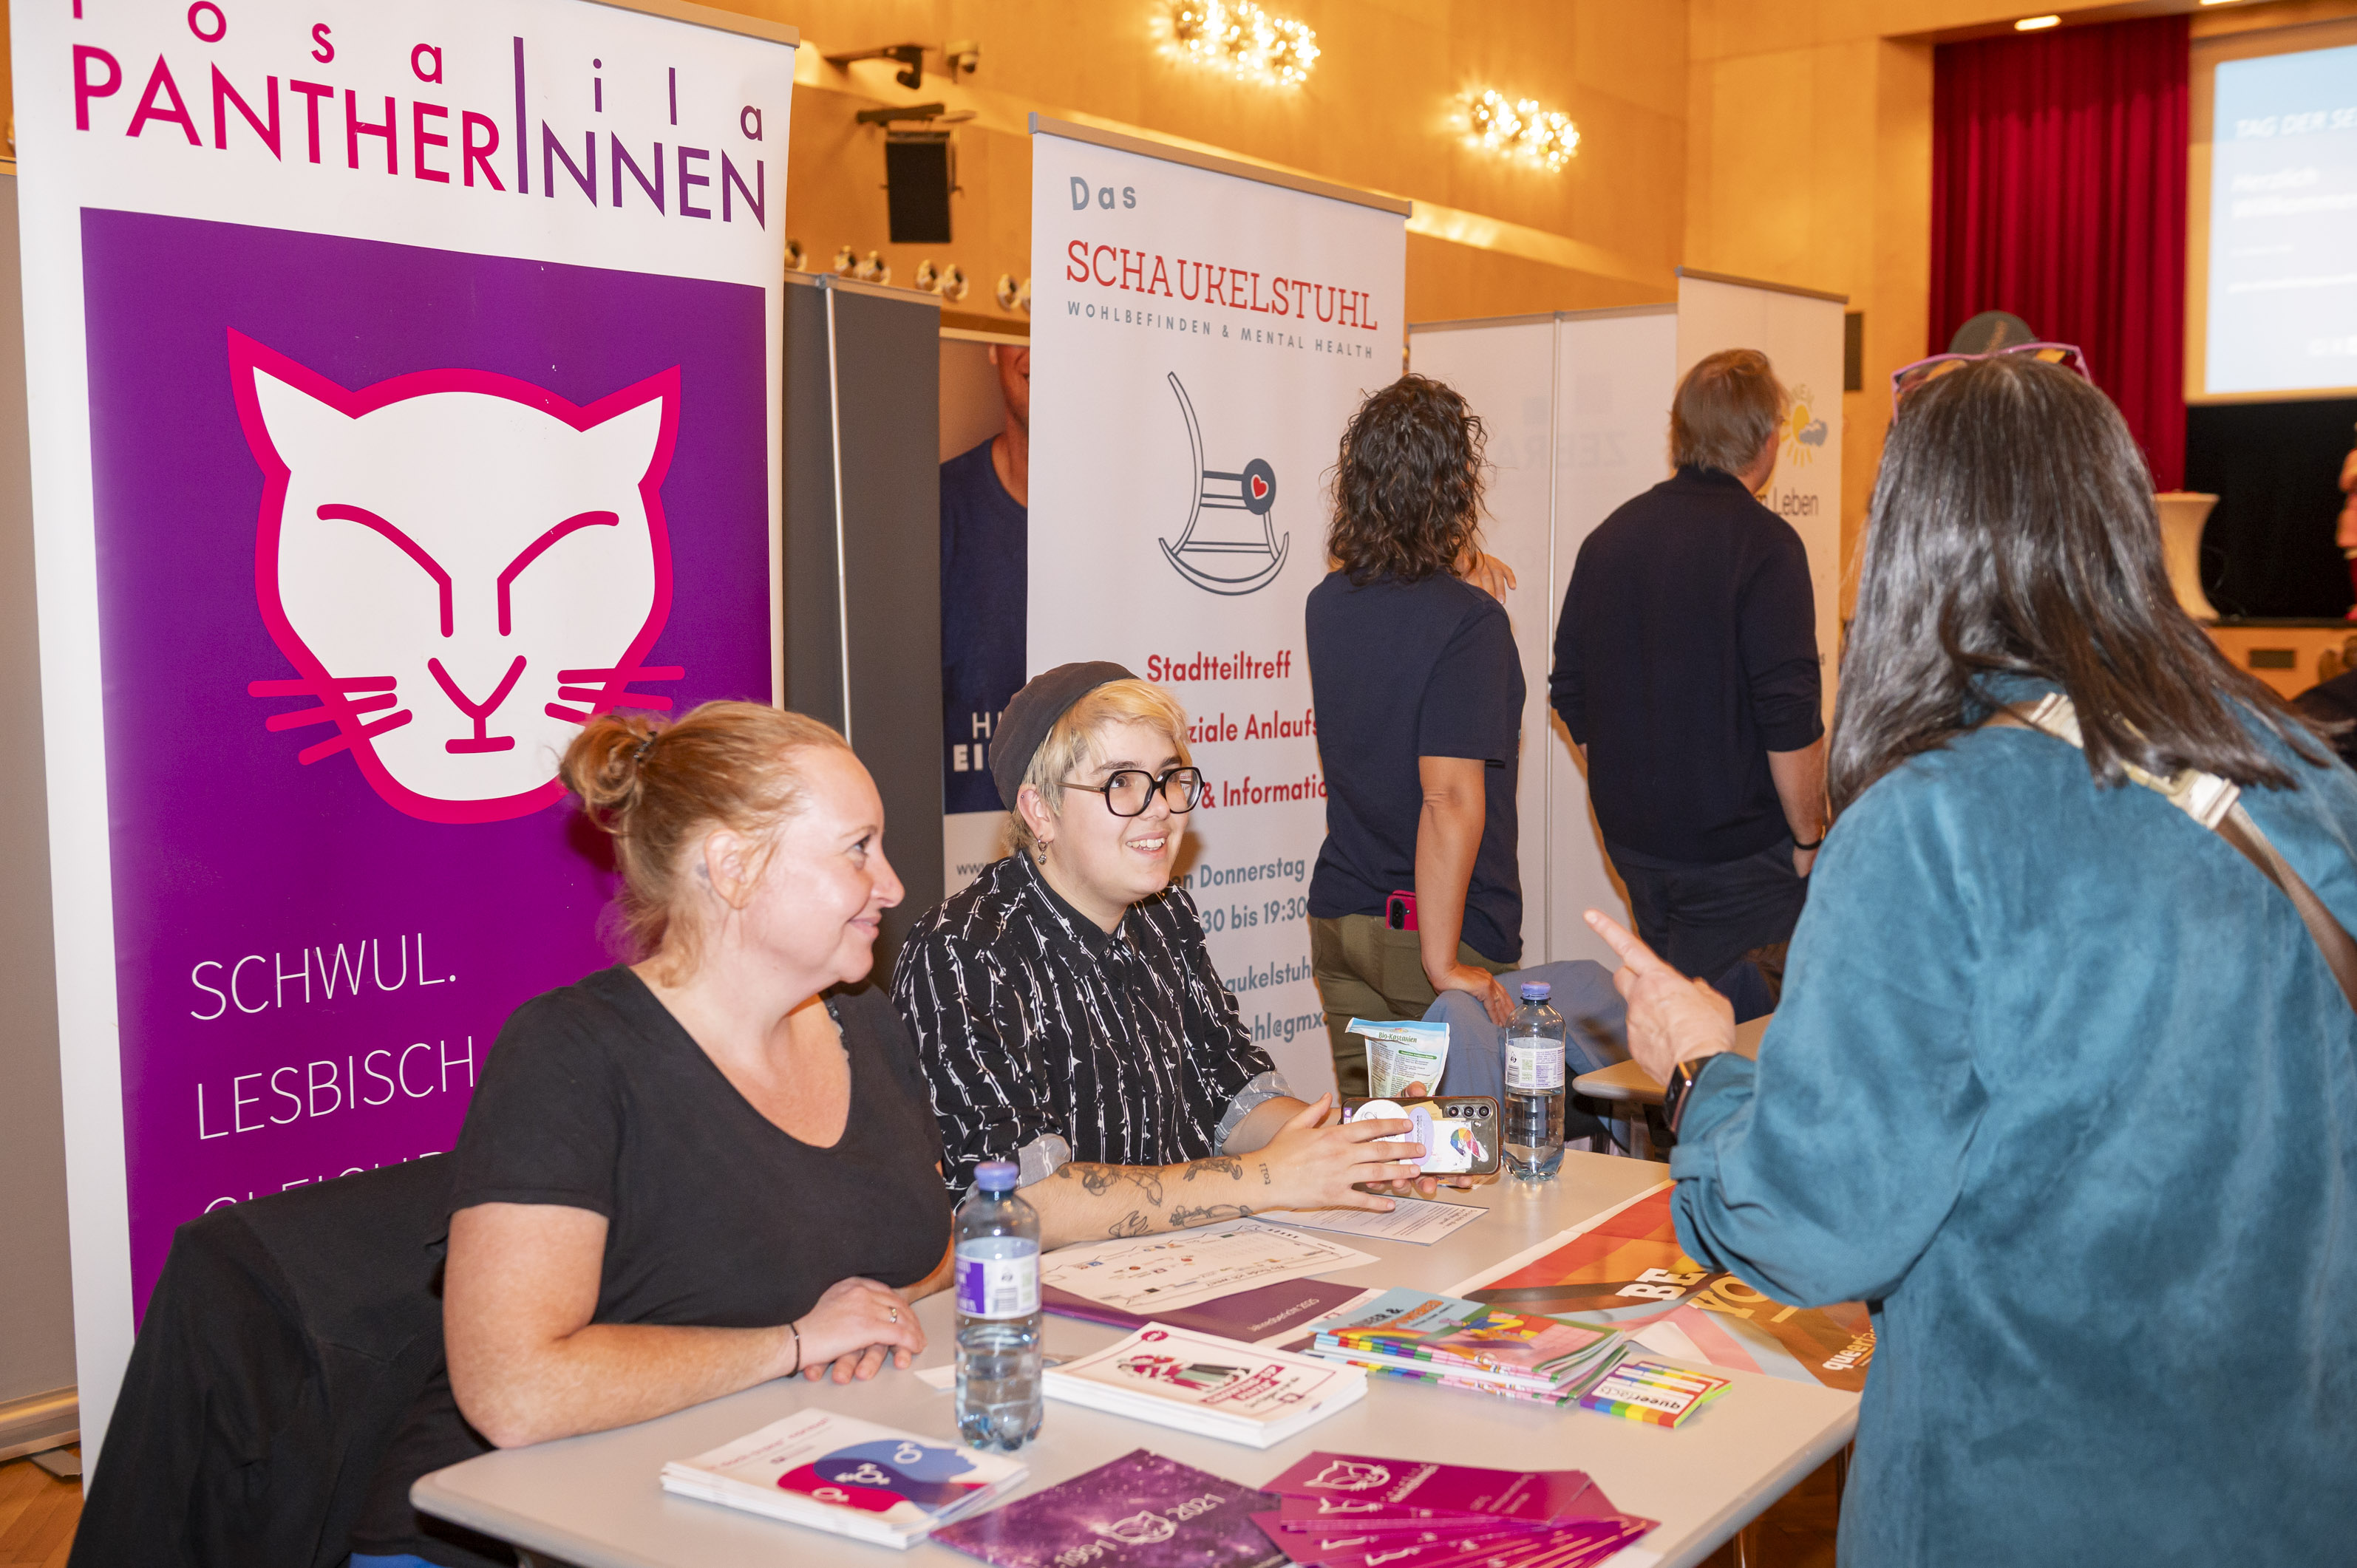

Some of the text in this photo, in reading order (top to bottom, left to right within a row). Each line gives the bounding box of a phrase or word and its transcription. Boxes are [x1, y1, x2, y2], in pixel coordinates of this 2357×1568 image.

[72, 36, 765, 231] PANTHERINNEN
[1069, 176, 1137, 211] Das
[1067, 239, 1378, 330] SCHAUKELSTUHL
[1067, 300, 1373, 359] WOHLBEFINDEN & MENTAL HEALTH
[1774, 487, 1819, 516] Leben
[1147, 650, 1291, 682] Stadtteiltreff
[1188, 712, 1238, 743] ziale
[952, 743, 992, 772] EI
[1201, 774, 1327, 809] & Informatio
[1175, 857, 1305, 890] en Donnerstag
[1202, 896, 1307, 934] 30 bis 19:30
[190, 933, 457, 1020] SCHWUL.
[1225, 955, 1312, 994] aukelstuh
[1378, 1032, 1418, 1043] Bio-Kastanien
[197, 1035, 474, 1140] LESBISCH
[1615, 1267, 1708, 1301] BE
[1686, 1271, 1770, 1318] YO
